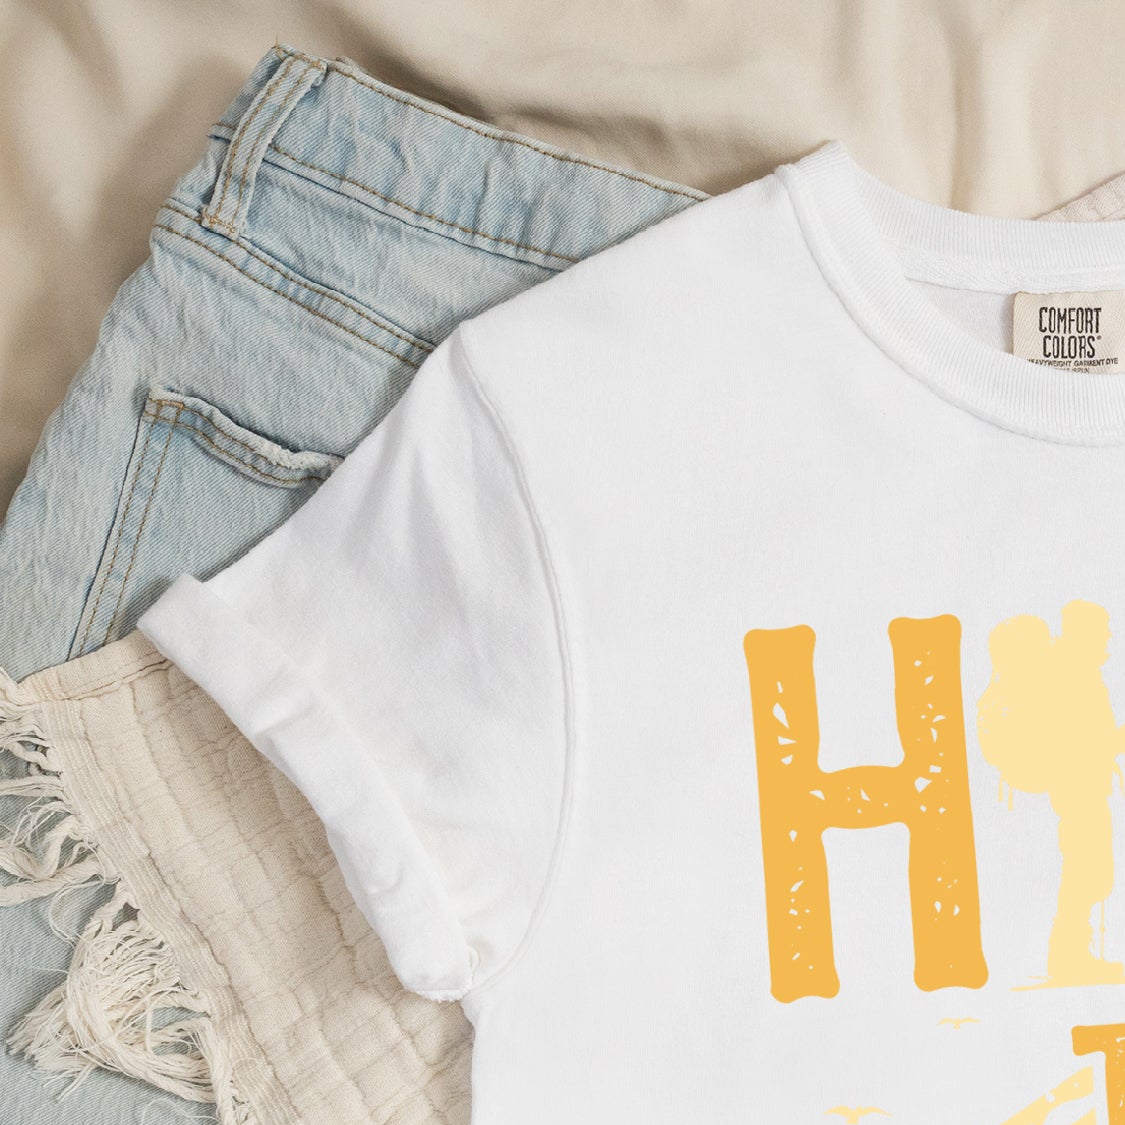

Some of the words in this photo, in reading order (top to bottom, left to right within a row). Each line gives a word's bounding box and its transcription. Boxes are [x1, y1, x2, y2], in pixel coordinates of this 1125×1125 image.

[1039, 306, 1102, 334] COMFORT
[1073, 359, 1105, 367] GARMENT
[1105, 357, 1119, 365] DYE
